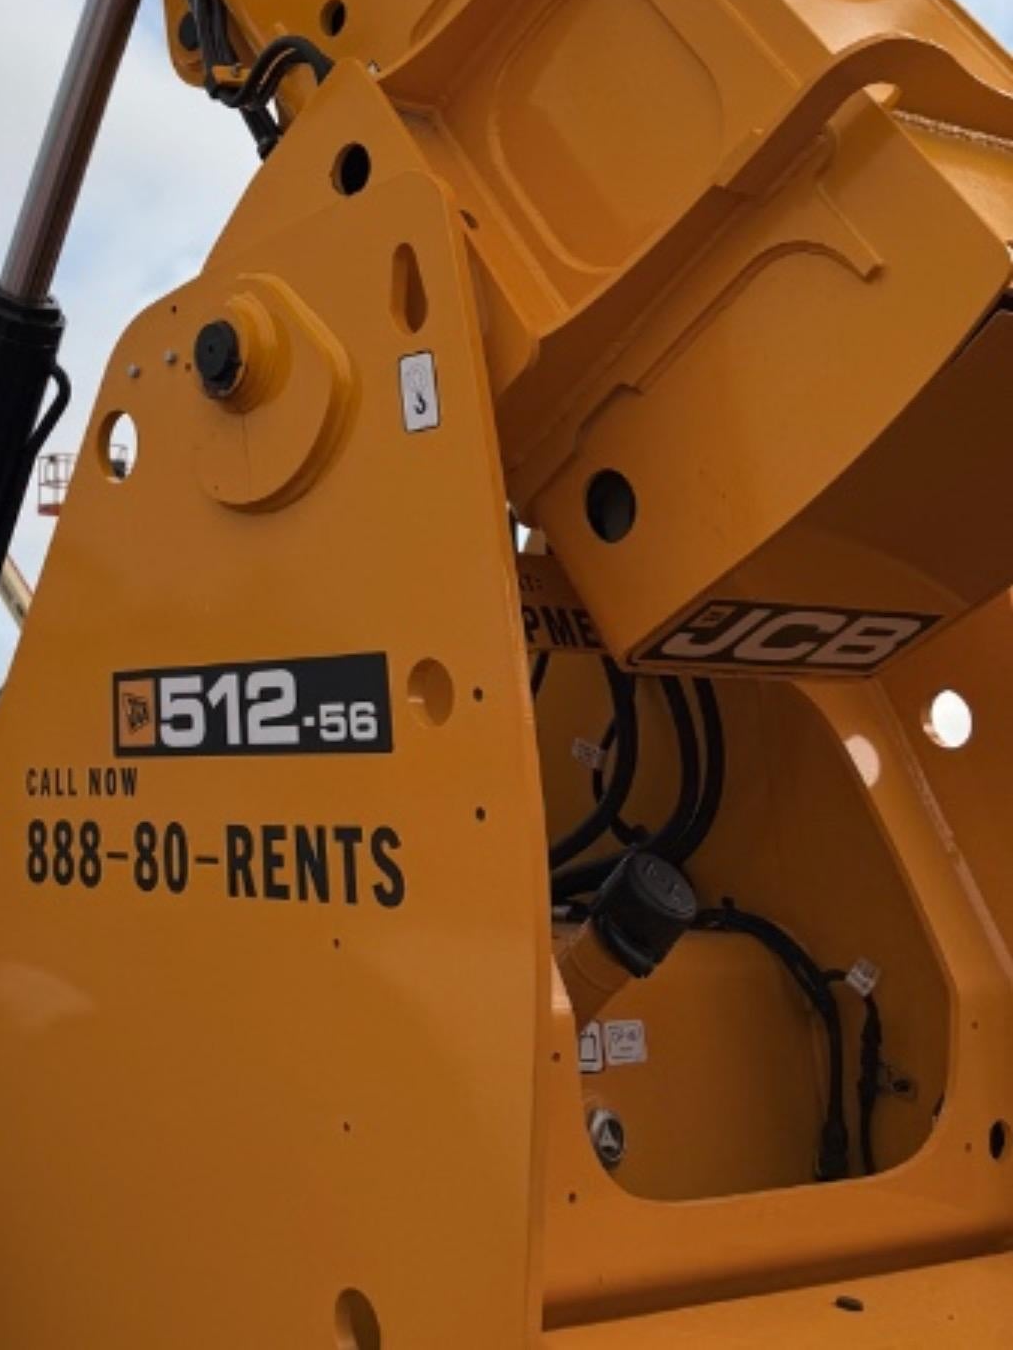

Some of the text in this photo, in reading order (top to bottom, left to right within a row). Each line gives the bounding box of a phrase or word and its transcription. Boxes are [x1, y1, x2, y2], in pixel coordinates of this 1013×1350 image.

[661, 607, 922, 666] JCB
[160, 669, 378, 748] 512-56
[26, 767, 138, 797] CALL NOW
[26, 819, 406, 909] 888-80-RENTS
